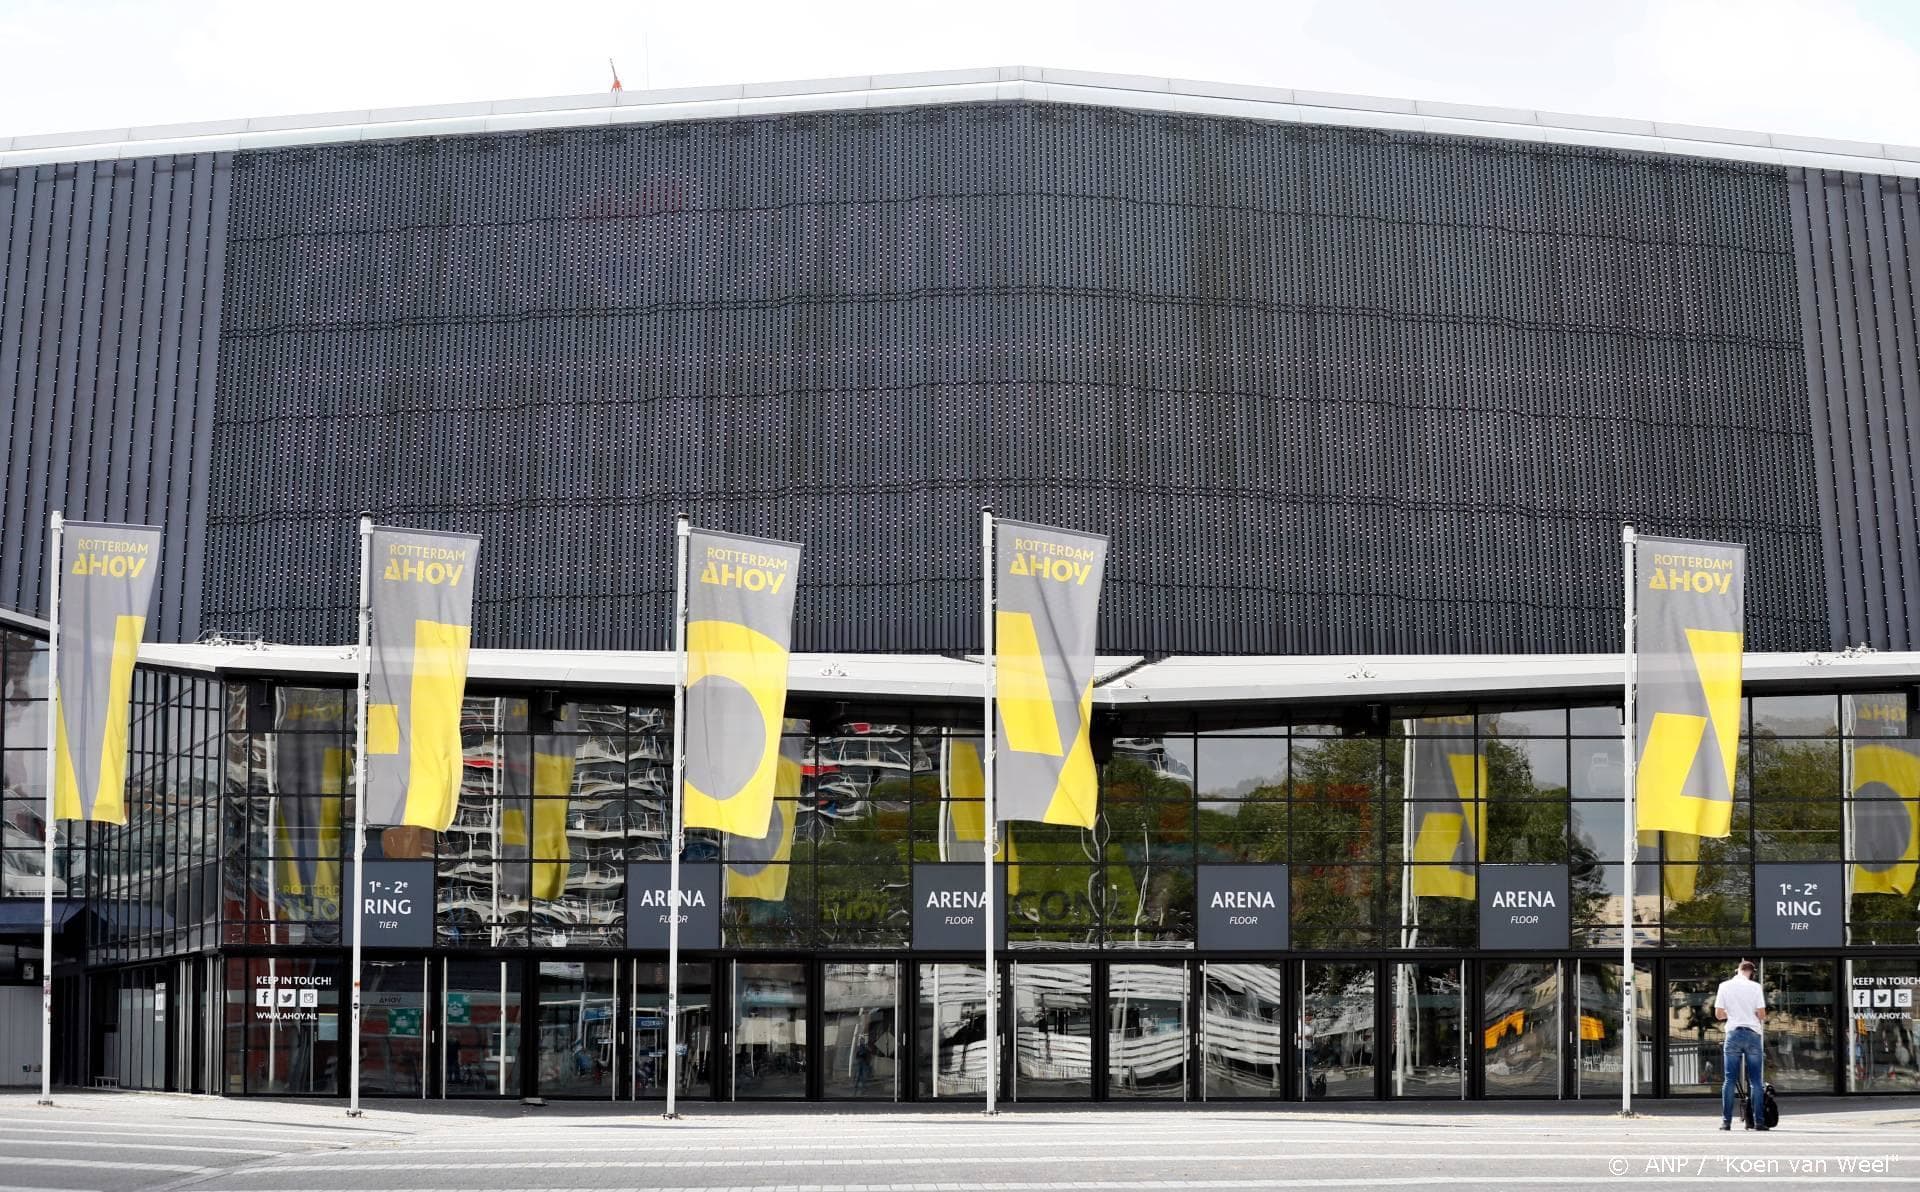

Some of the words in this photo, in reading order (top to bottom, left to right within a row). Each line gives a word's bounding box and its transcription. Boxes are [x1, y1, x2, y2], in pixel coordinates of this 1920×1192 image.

[78, 538, 149, 554] ROTTERDAM
[390, 544, 466, 561] ROTTERDAM
[1015, 537, 1094, 562] ROTTERDAM
[72, 553, 147, 578] AHOY
[707, 547, 788, 571] ROTTERDAM
[1654, 554, 1733, 570] ROTTERDAM
[384, 558, 464, 587] AHOY
[701, 560, 786, 595] AHOY
[1009, 552, 1092, 586] AHOY
[1649, 567, 1732, 595] AHOY
[364, 898, 412, 915] RING
[1211, 891, 1276, 908] ARENA
[1492, 891, 1556, 908] ARENA
[1776, 900, 1822, 917] RING
[379, 921, 398, 929] TIER
[945, 916, 974, 925] FLOOR
[1229, 916, 1258, 925] FLOOR
[1510, 915, 1539, 924] FLOOR
[1790, 922, 1809, 930] TIER
[256, 976, 279, 985] KEEP
[281, 976, 292, 985] IN
[293, 976, 332, 986] TOUCH!
[1853, 977, 1875, 985] KEEP
[1876, 977, 1887, 986] IN
